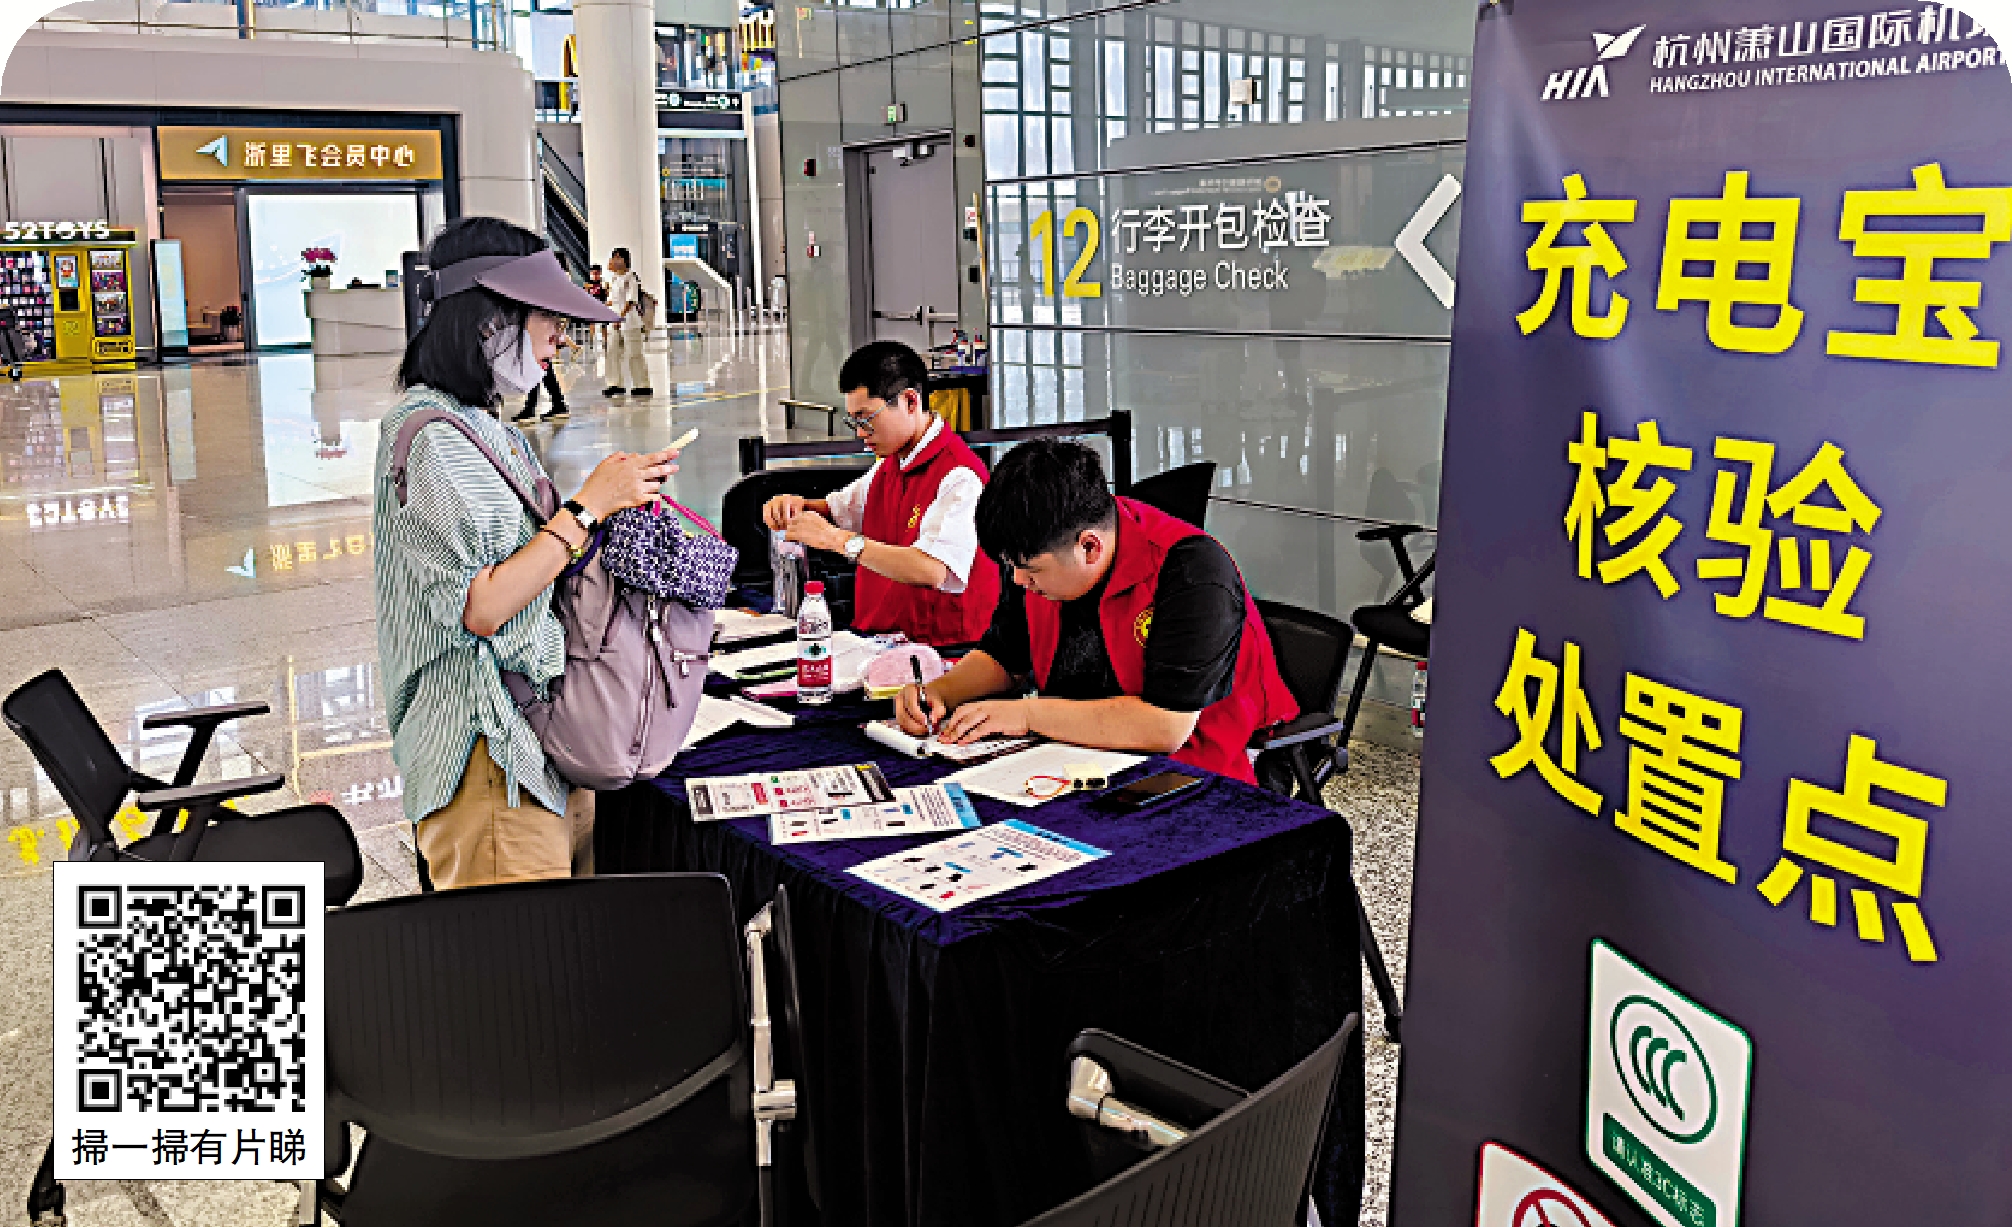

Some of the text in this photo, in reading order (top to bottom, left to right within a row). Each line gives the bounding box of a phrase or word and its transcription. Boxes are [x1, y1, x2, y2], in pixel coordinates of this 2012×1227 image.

[1650, 69, 1751, 93] HANGZHOU
[1754, 56, 1912, 86] INTERNATIONAL
[244, 141, 415, 168] 浙里飞会员中心
[5, 221, 110, 240] 52TOYS
[1029, 206, 1102, 298] 12
[1110, 190, 1331, 253] 行李开包检查
[1110, 259, 1290, 297] Baggage Check
[1515, 163, 2011, 368] 充电宝
[1563, 411, 1883, 640] 核验
[1489, 626, 1947, 962] 处置点
